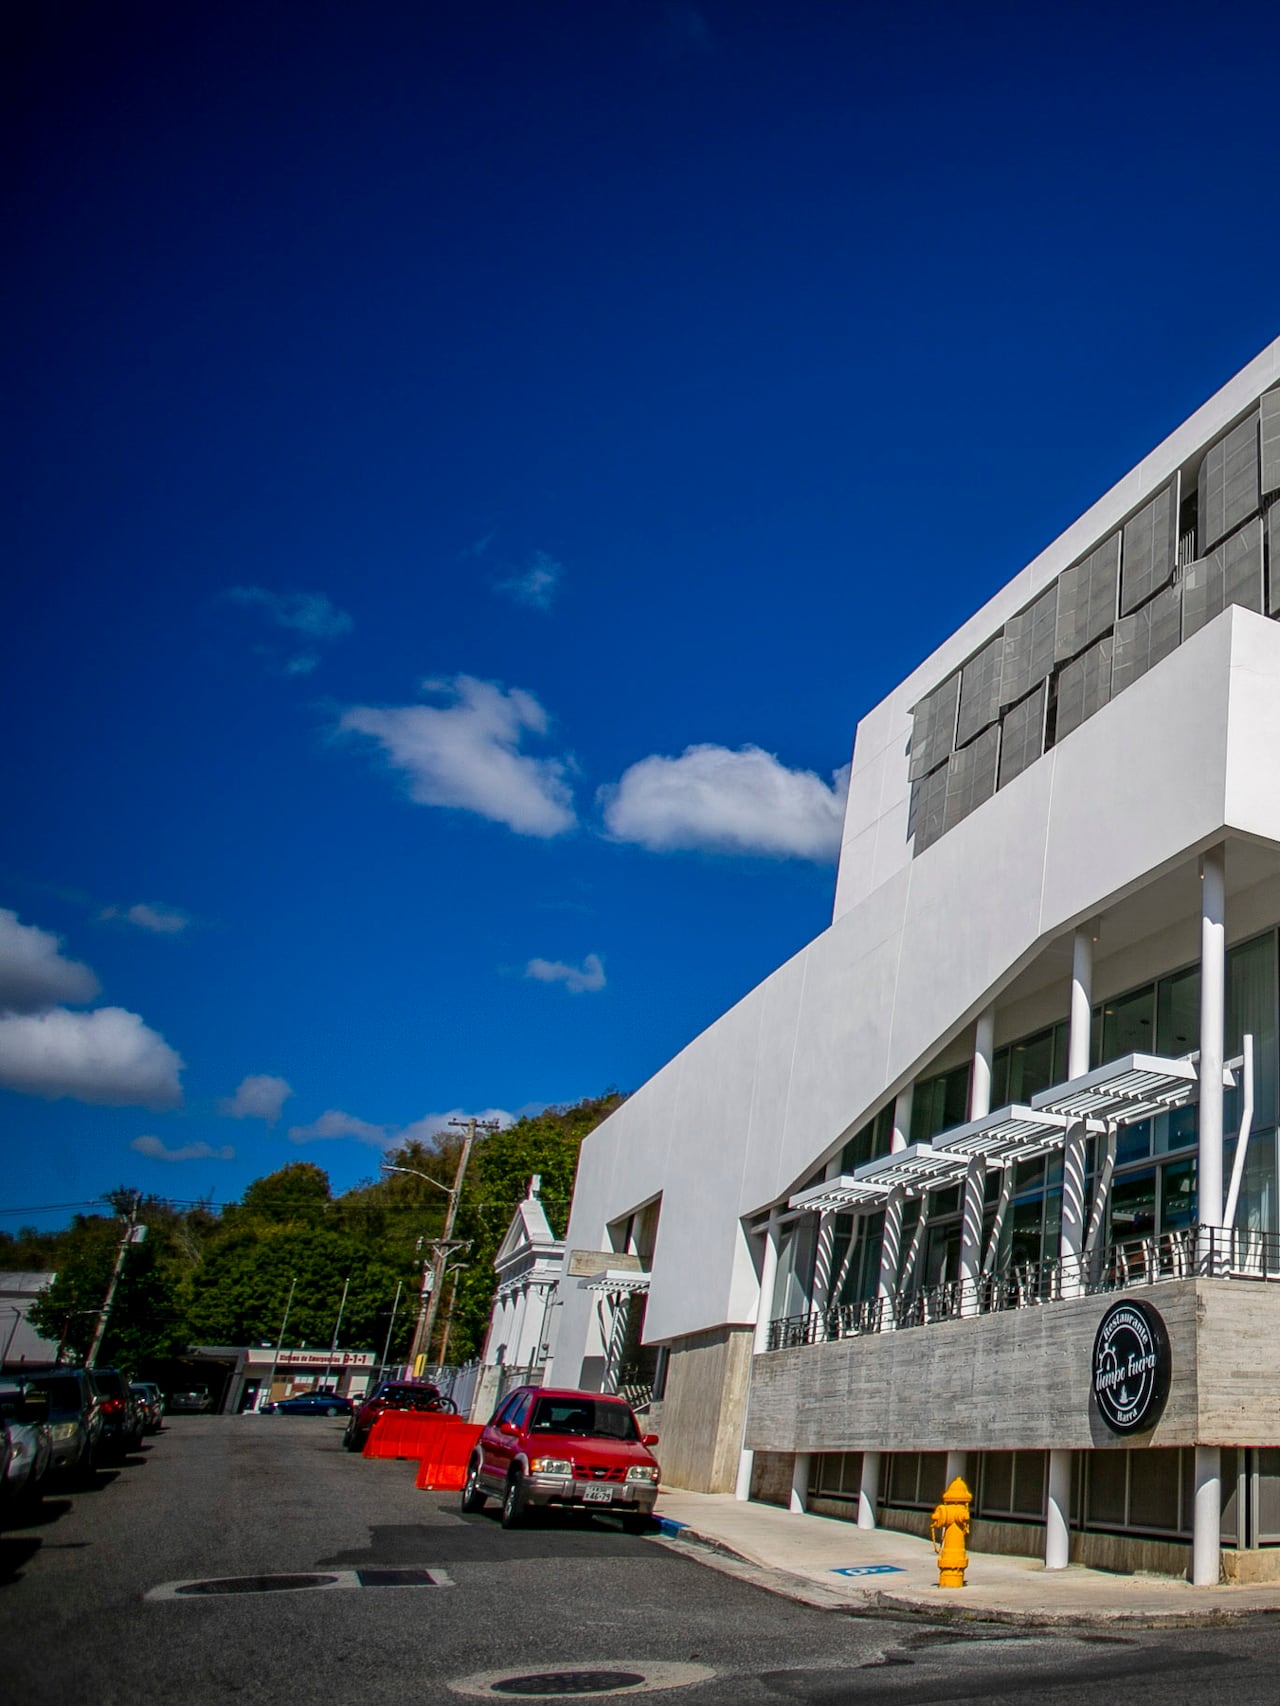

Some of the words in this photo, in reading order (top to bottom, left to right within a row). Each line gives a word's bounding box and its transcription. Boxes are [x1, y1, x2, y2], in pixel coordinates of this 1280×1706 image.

[1103, 1312, 1149, 1345] Restaurante
[1096, 1366, 1125, 1392] Tiempo
[1128, 1353, 1156, 1377] Fuera
[1117, 1408, 1138, 1423] Barra
